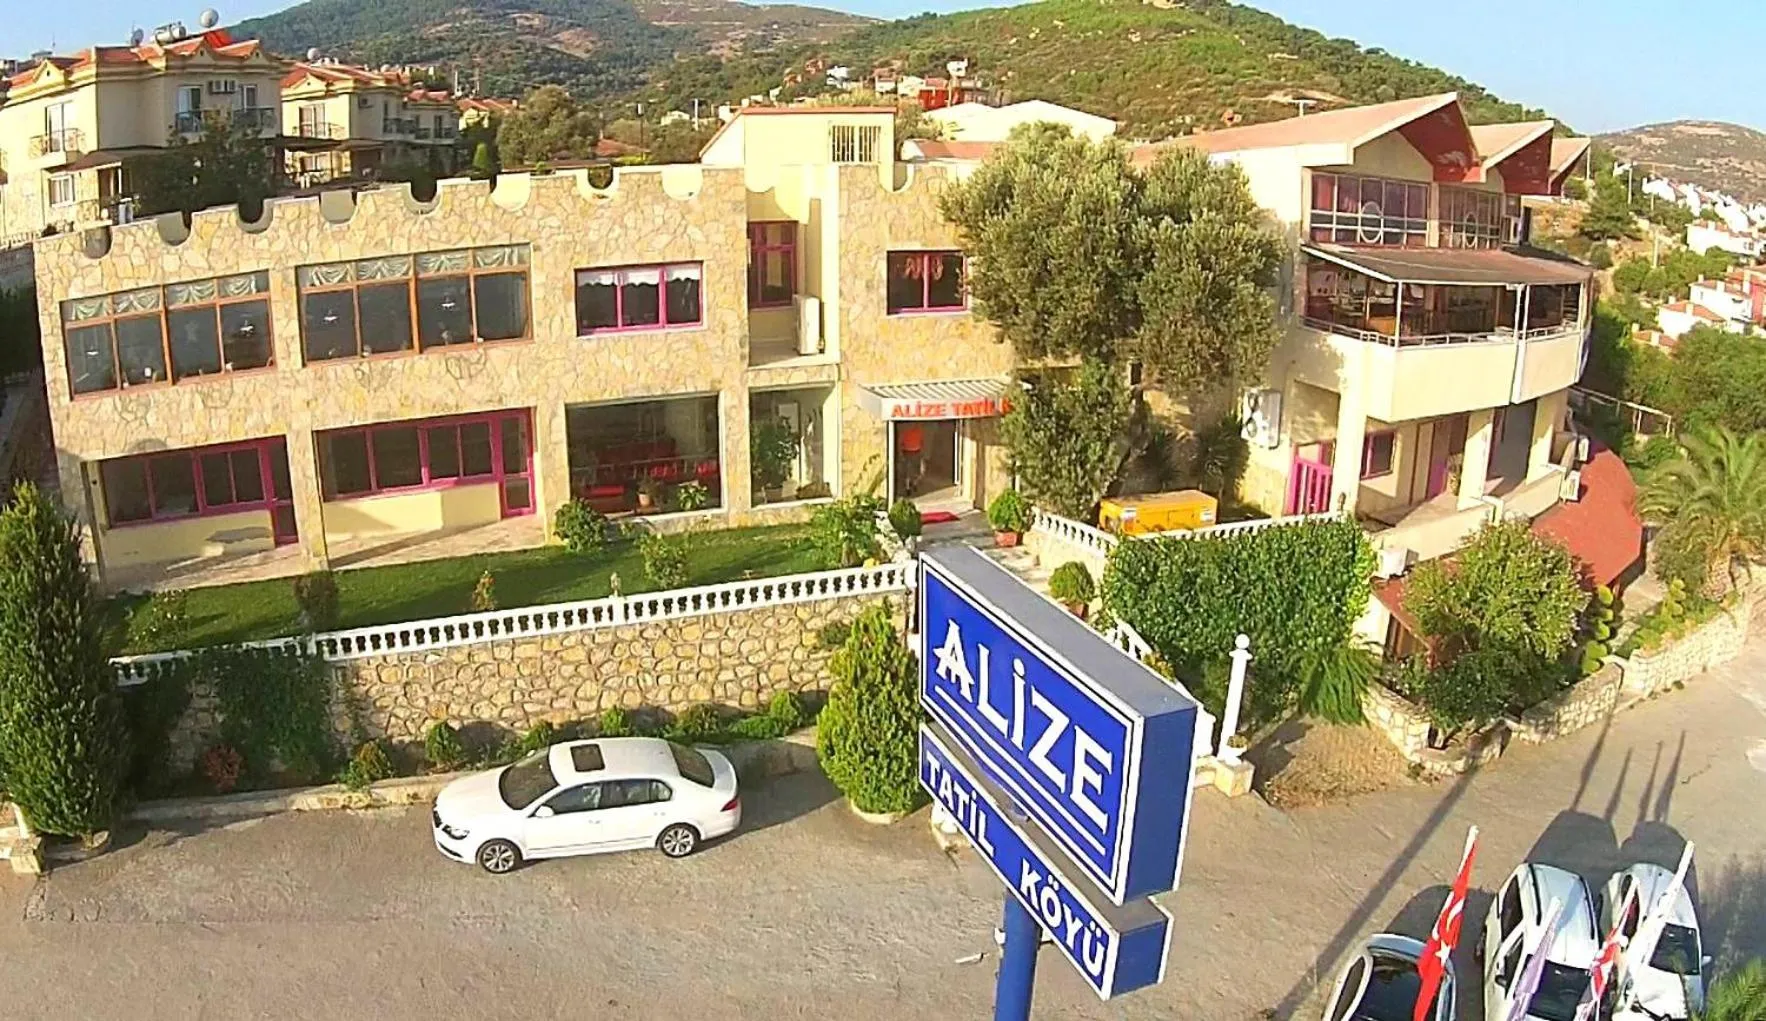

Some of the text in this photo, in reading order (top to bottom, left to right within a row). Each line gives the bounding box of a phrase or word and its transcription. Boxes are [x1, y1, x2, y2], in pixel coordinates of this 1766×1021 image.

[891, 400, 947, 417] ALİZE
[933, 619, 1113, 835] ALİZE
[926, 750, 1107, 977] TATİL KÖYÜ
